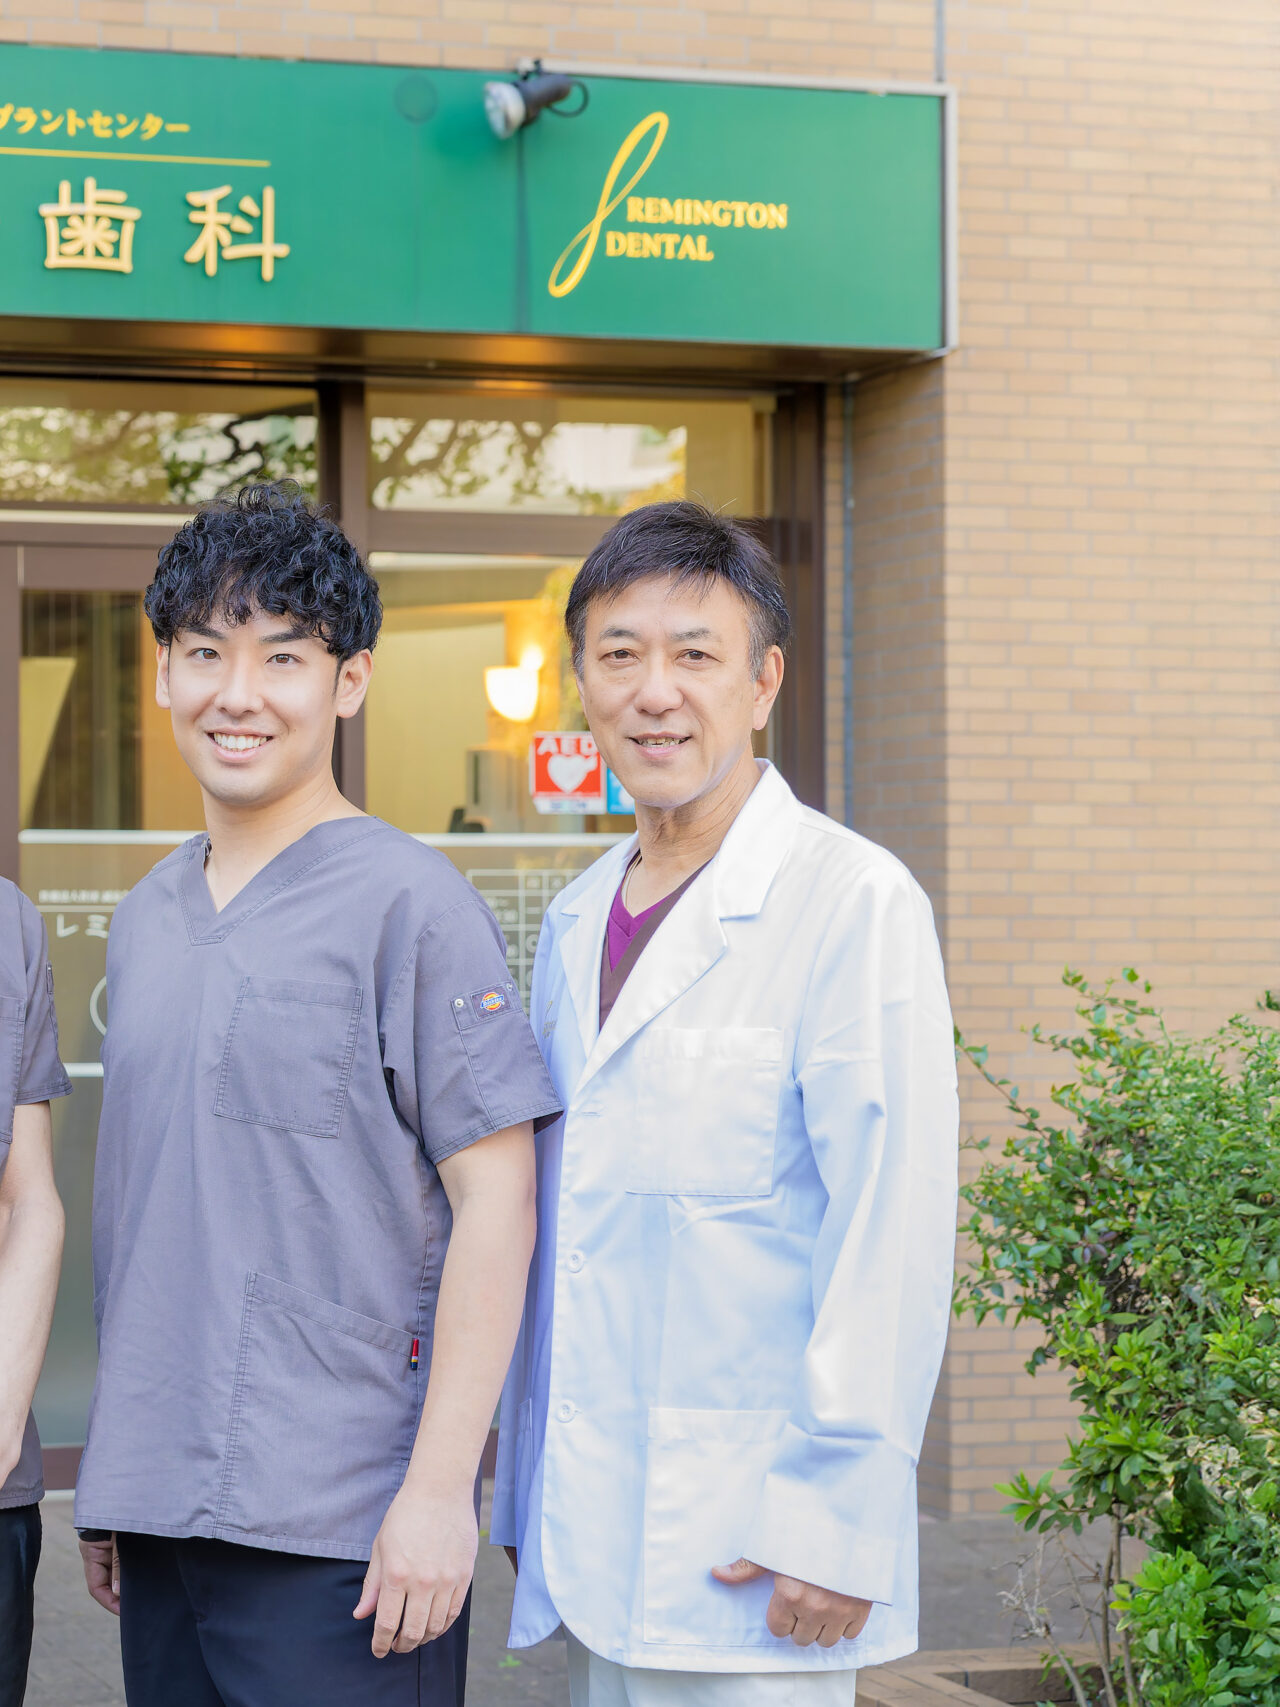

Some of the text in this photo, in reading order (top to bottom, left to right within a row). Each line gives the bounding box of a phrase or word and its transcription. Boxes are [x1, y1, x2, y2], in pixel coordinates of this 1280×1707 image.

[626, 196, 788, 229] REMINGTON
[605, 231, 715, 261] DENTAL
[537, 737, 598, 756] AED
